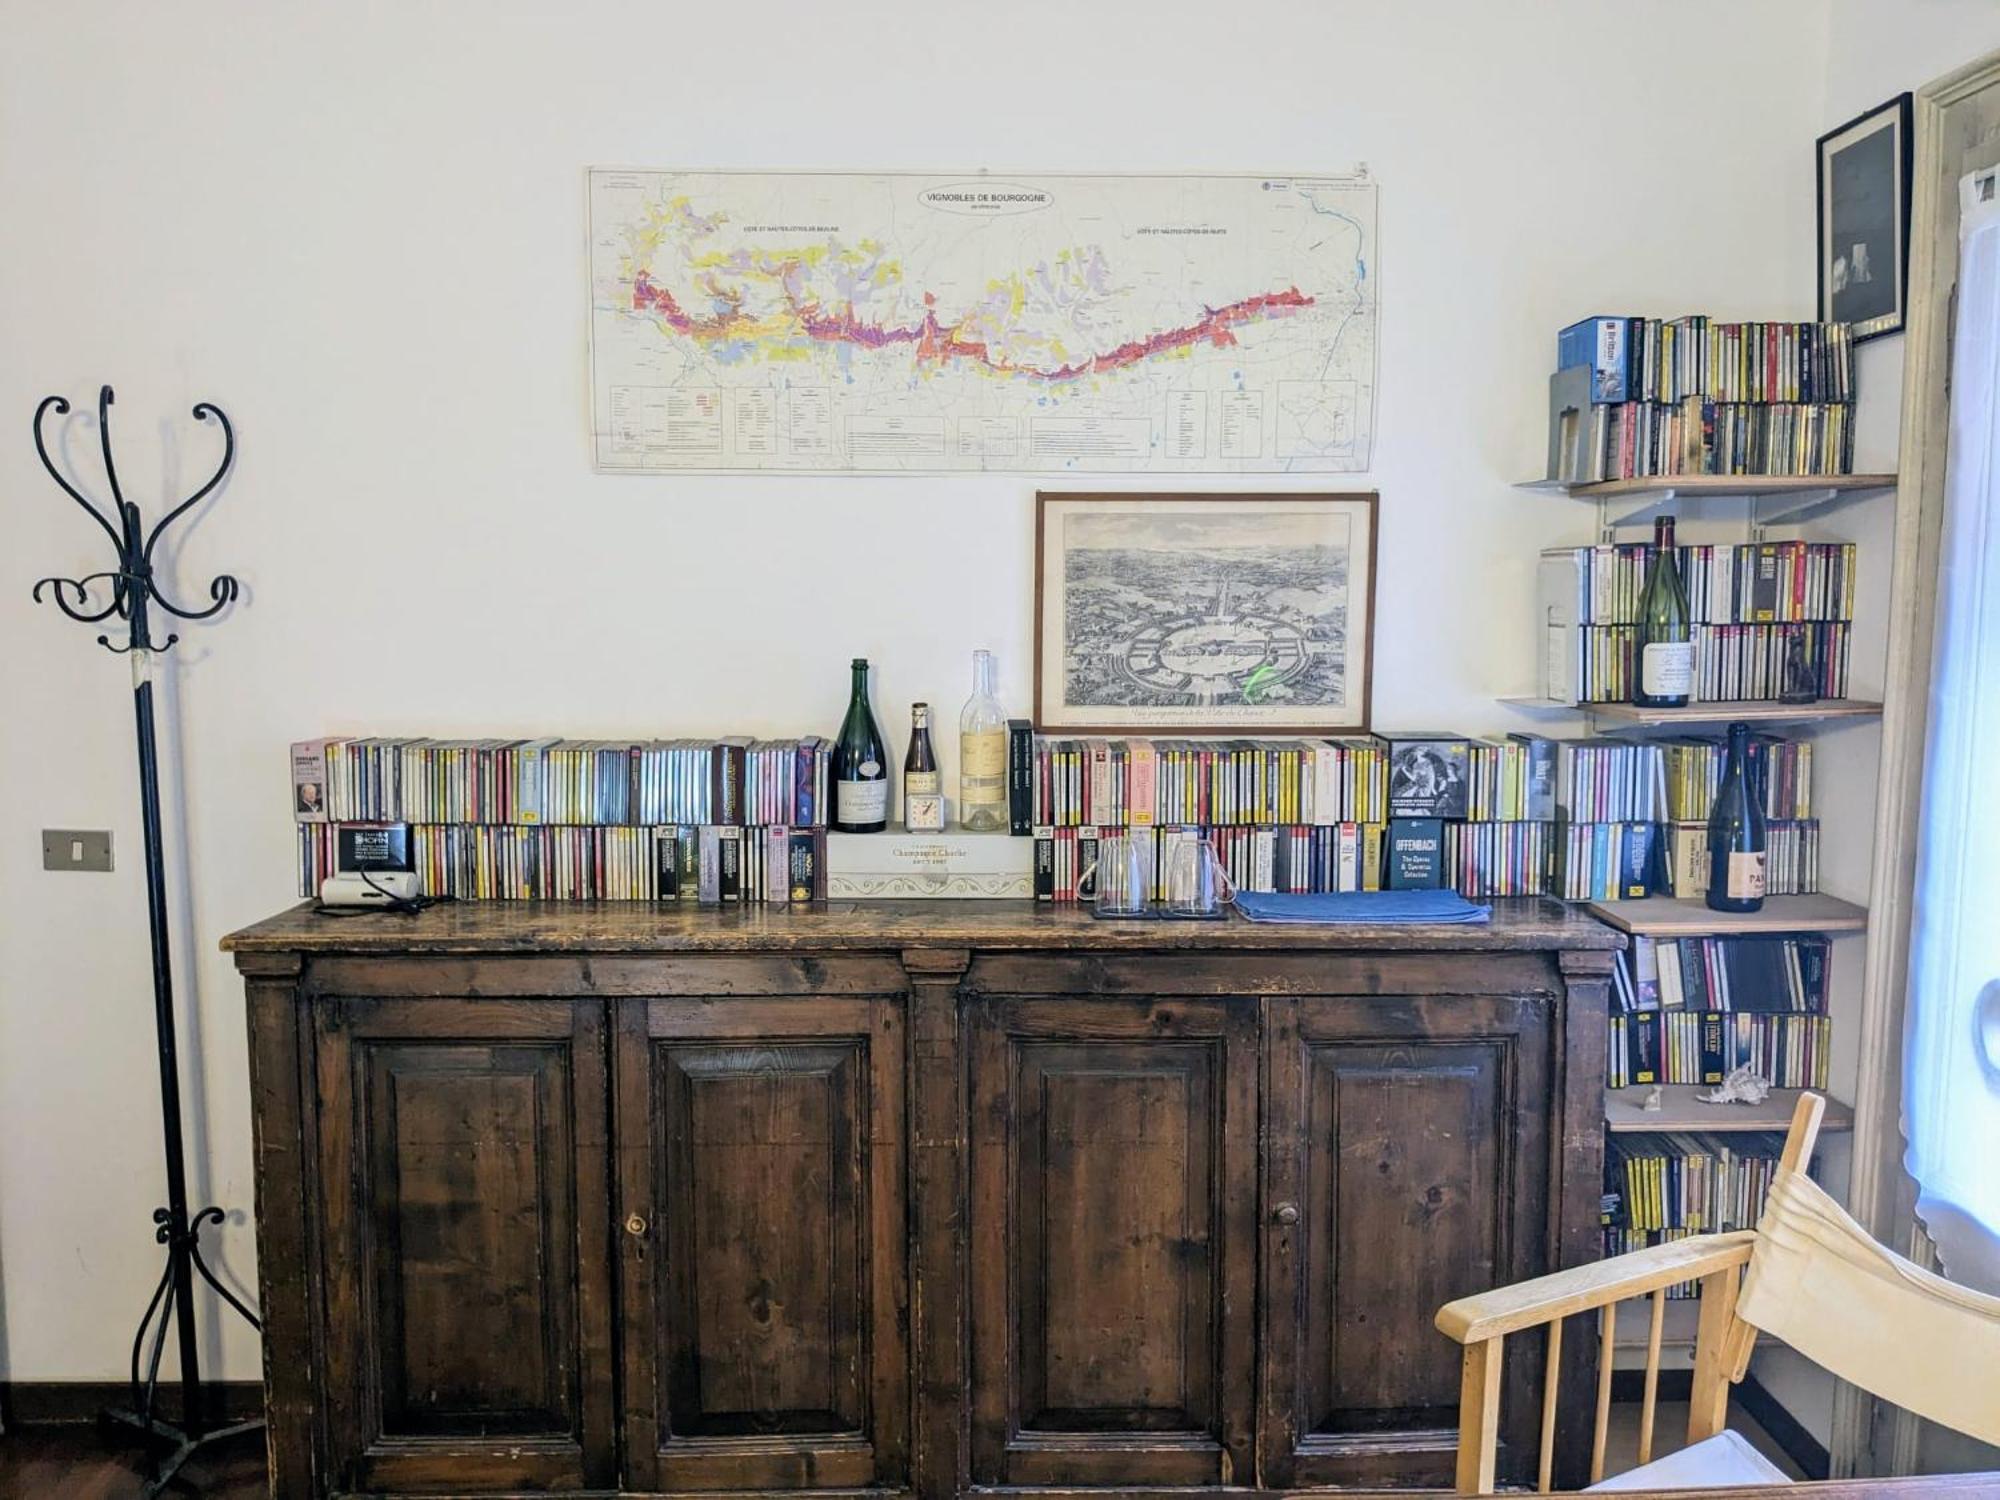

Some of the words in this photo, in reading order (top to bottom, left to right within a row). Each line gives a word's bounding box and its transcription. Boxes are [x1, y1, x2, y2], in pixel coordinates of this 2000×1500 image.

[927, 193, 976, 202] VIGNOBLES
[977, 193, 989, 202] DE
[991, 193, 1046, 202] BOURGOGNE
[1395, 839, 1437, 852] OFFENBACH
